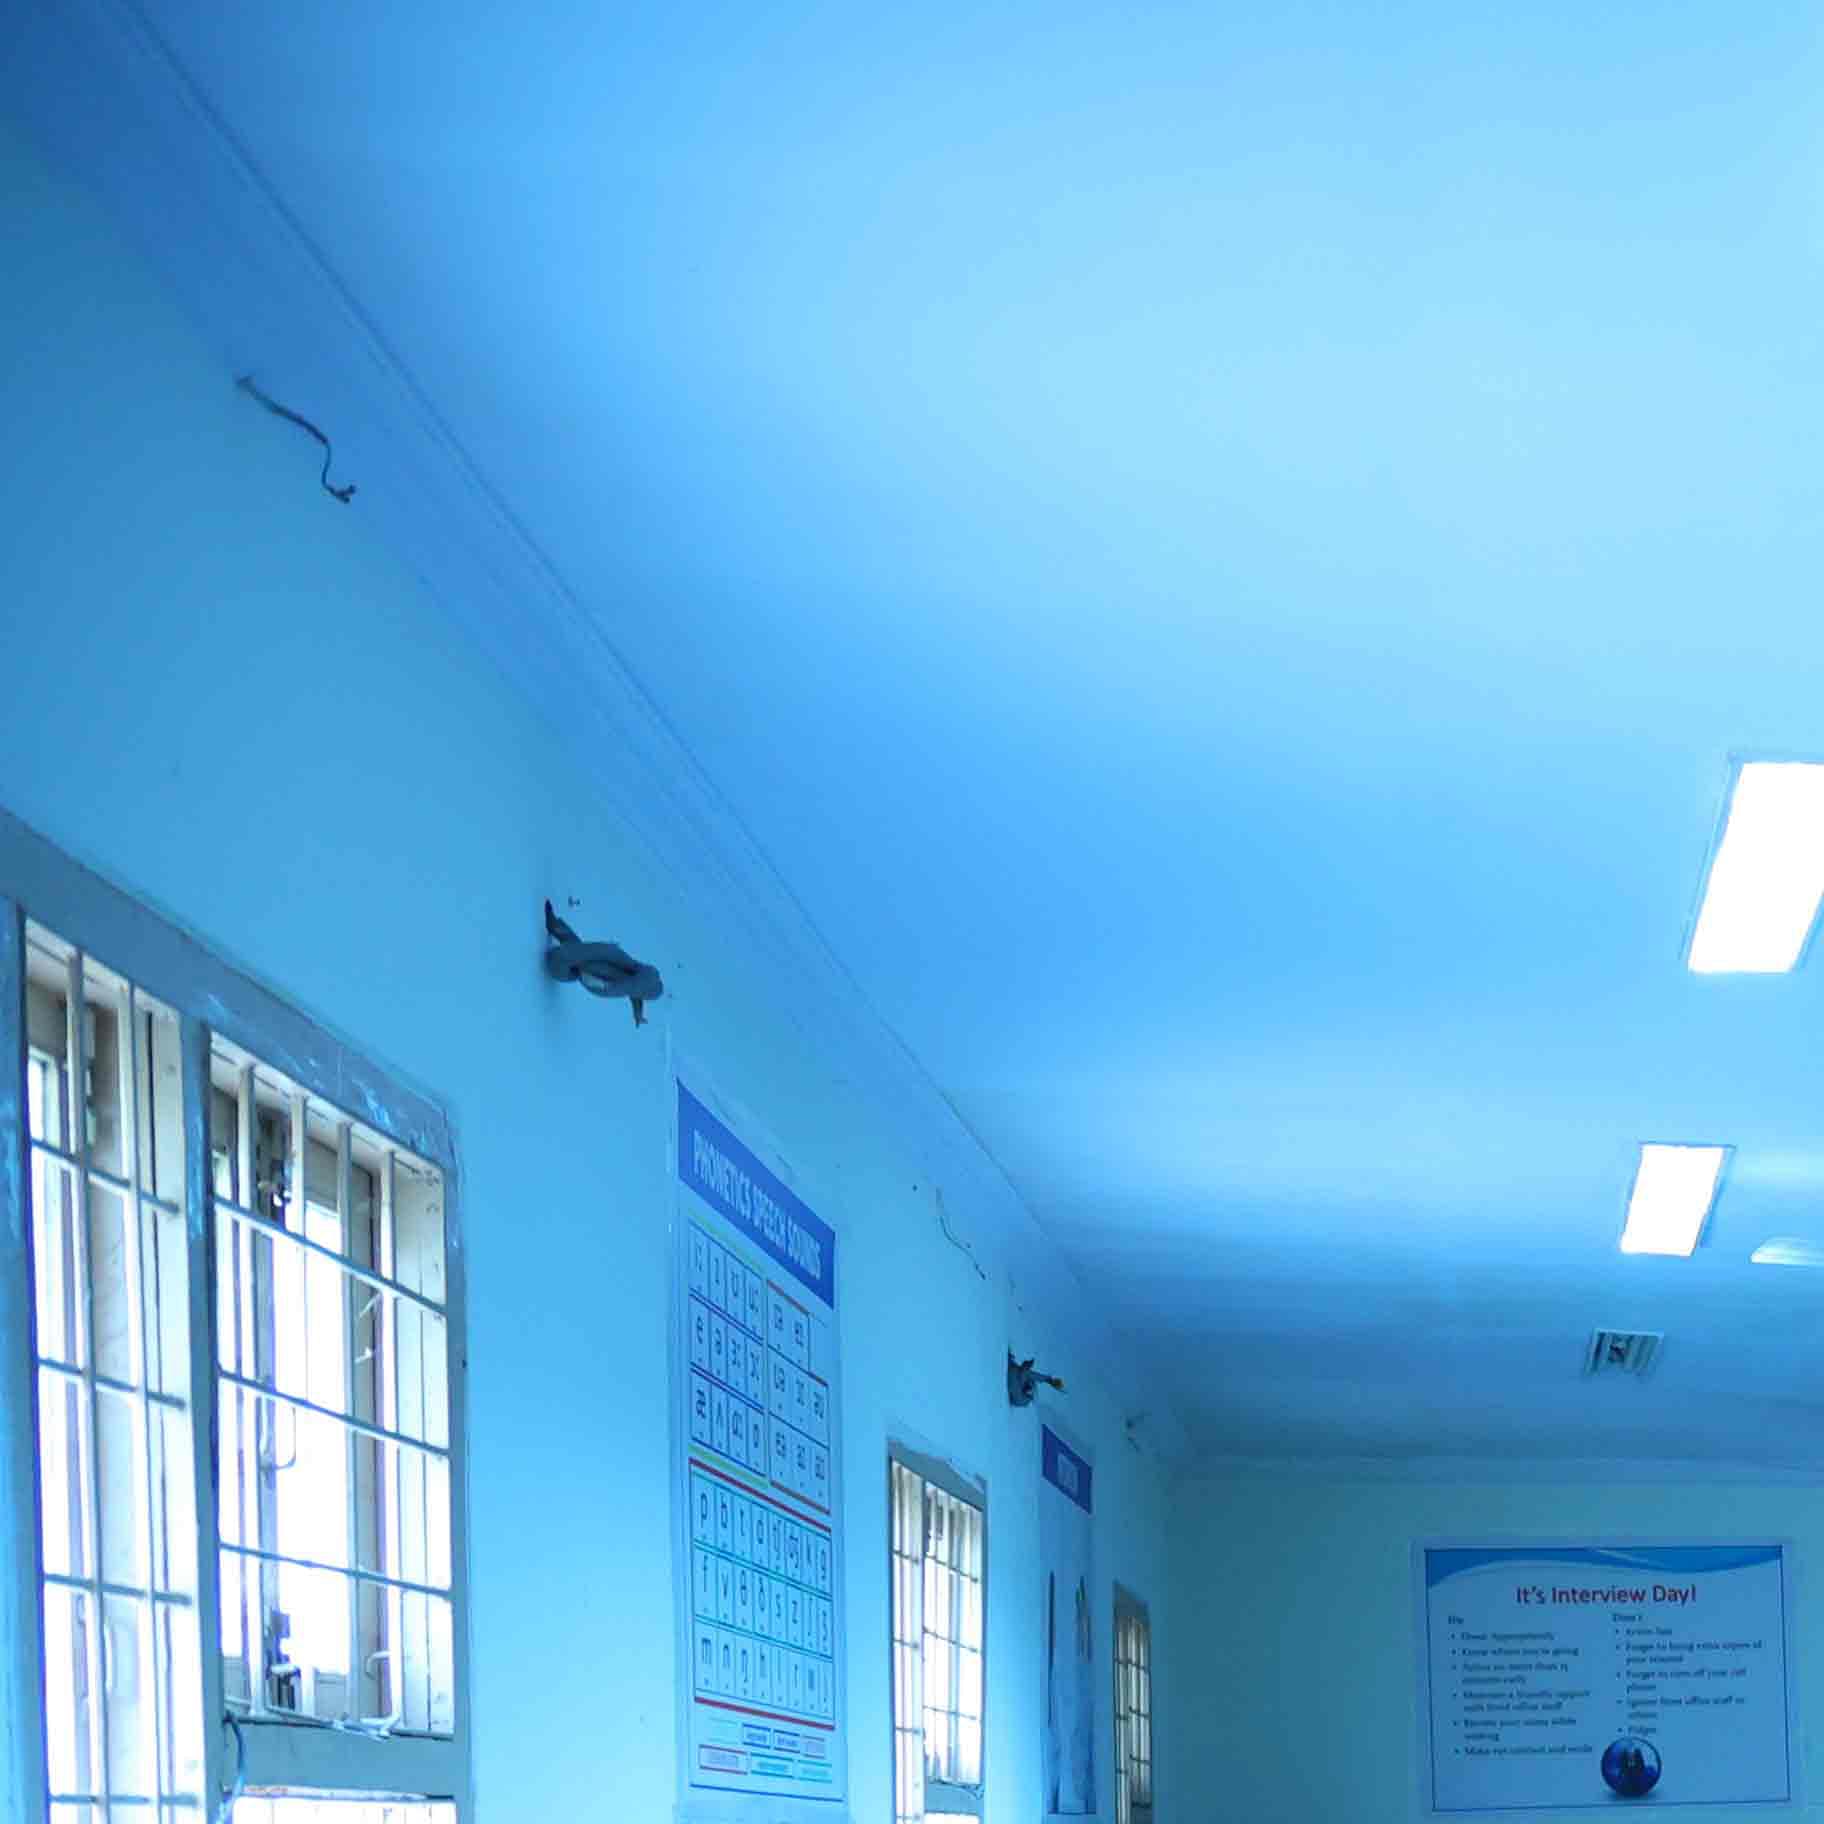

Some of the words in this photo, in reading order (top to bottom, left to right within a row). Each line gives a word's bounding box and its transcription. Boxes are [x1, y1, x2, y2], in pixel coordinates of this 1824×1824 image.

[1516, 1585, 1546, 1605] It's
[1551, 1586, 1647, 1604] Interview
[1652, 1584, 1697, 1605] Day!
